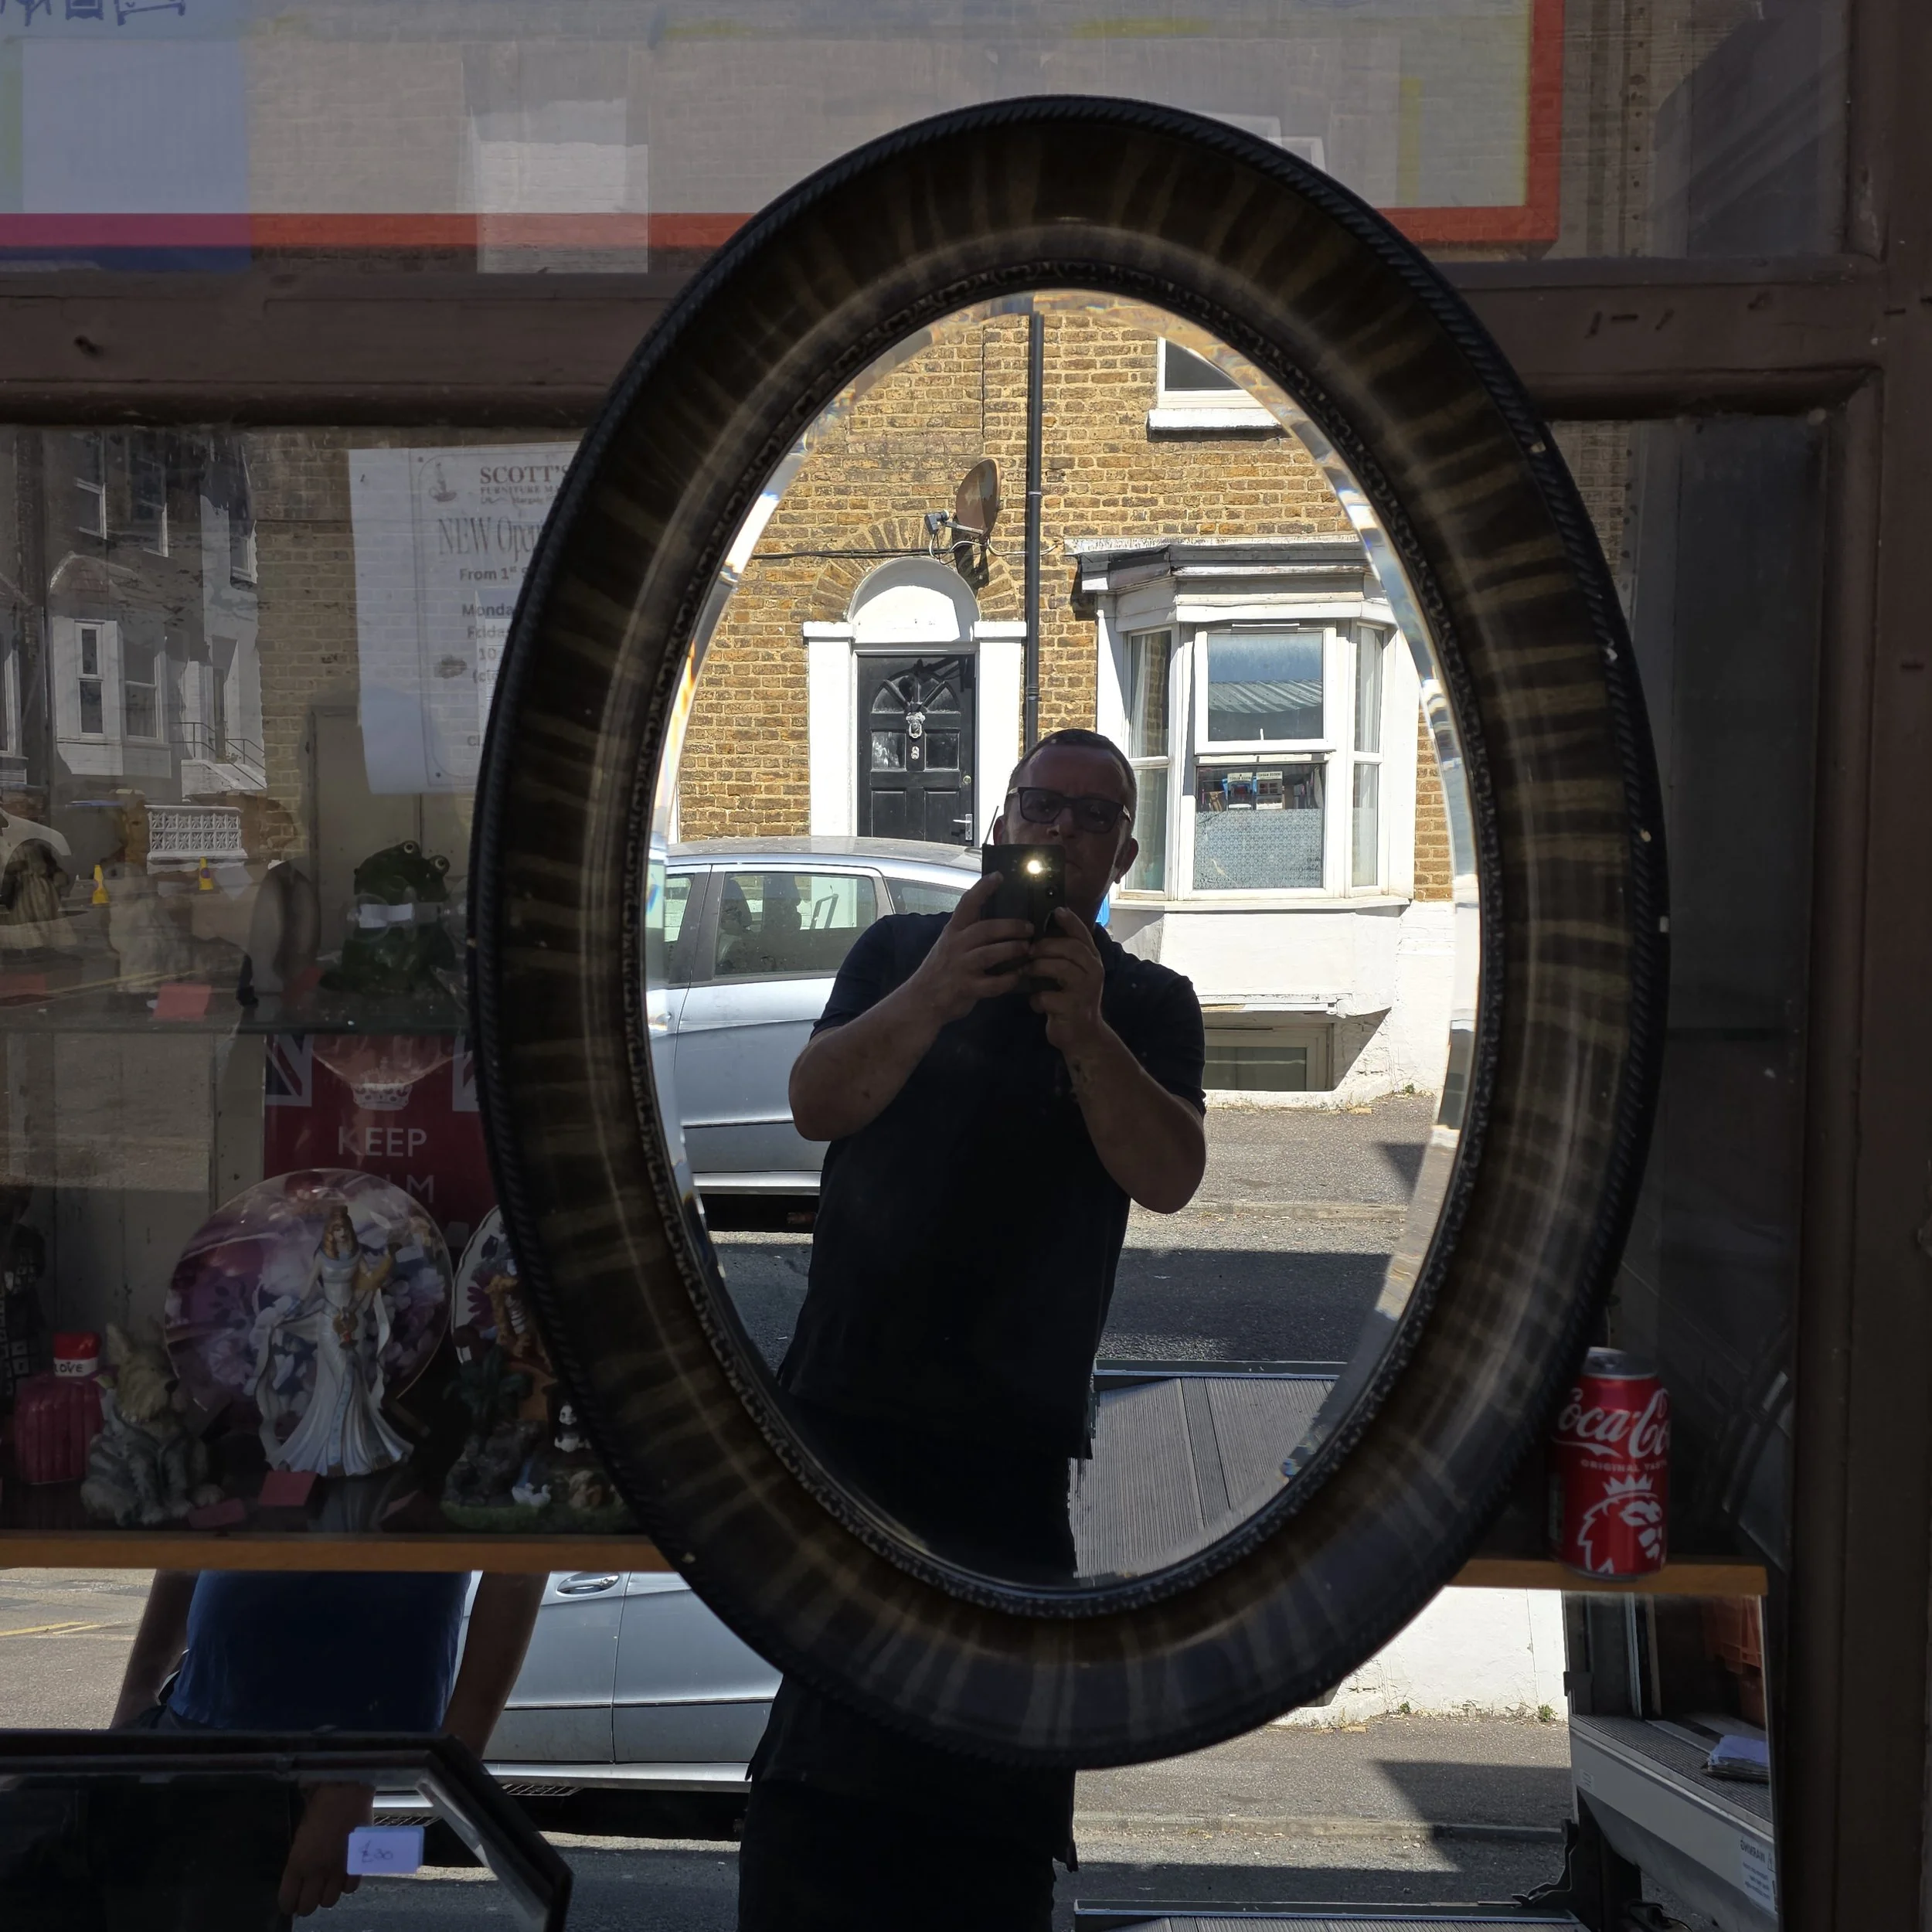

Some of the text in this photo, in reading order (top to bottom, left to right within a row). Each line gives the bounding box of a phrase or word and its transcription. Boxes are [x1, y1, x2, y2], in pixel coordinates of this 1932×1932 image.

[438, 517, 492, 555] NEW
[459, 568, 497, 580] From
[338, 1125, 428, 1158] KEEP
